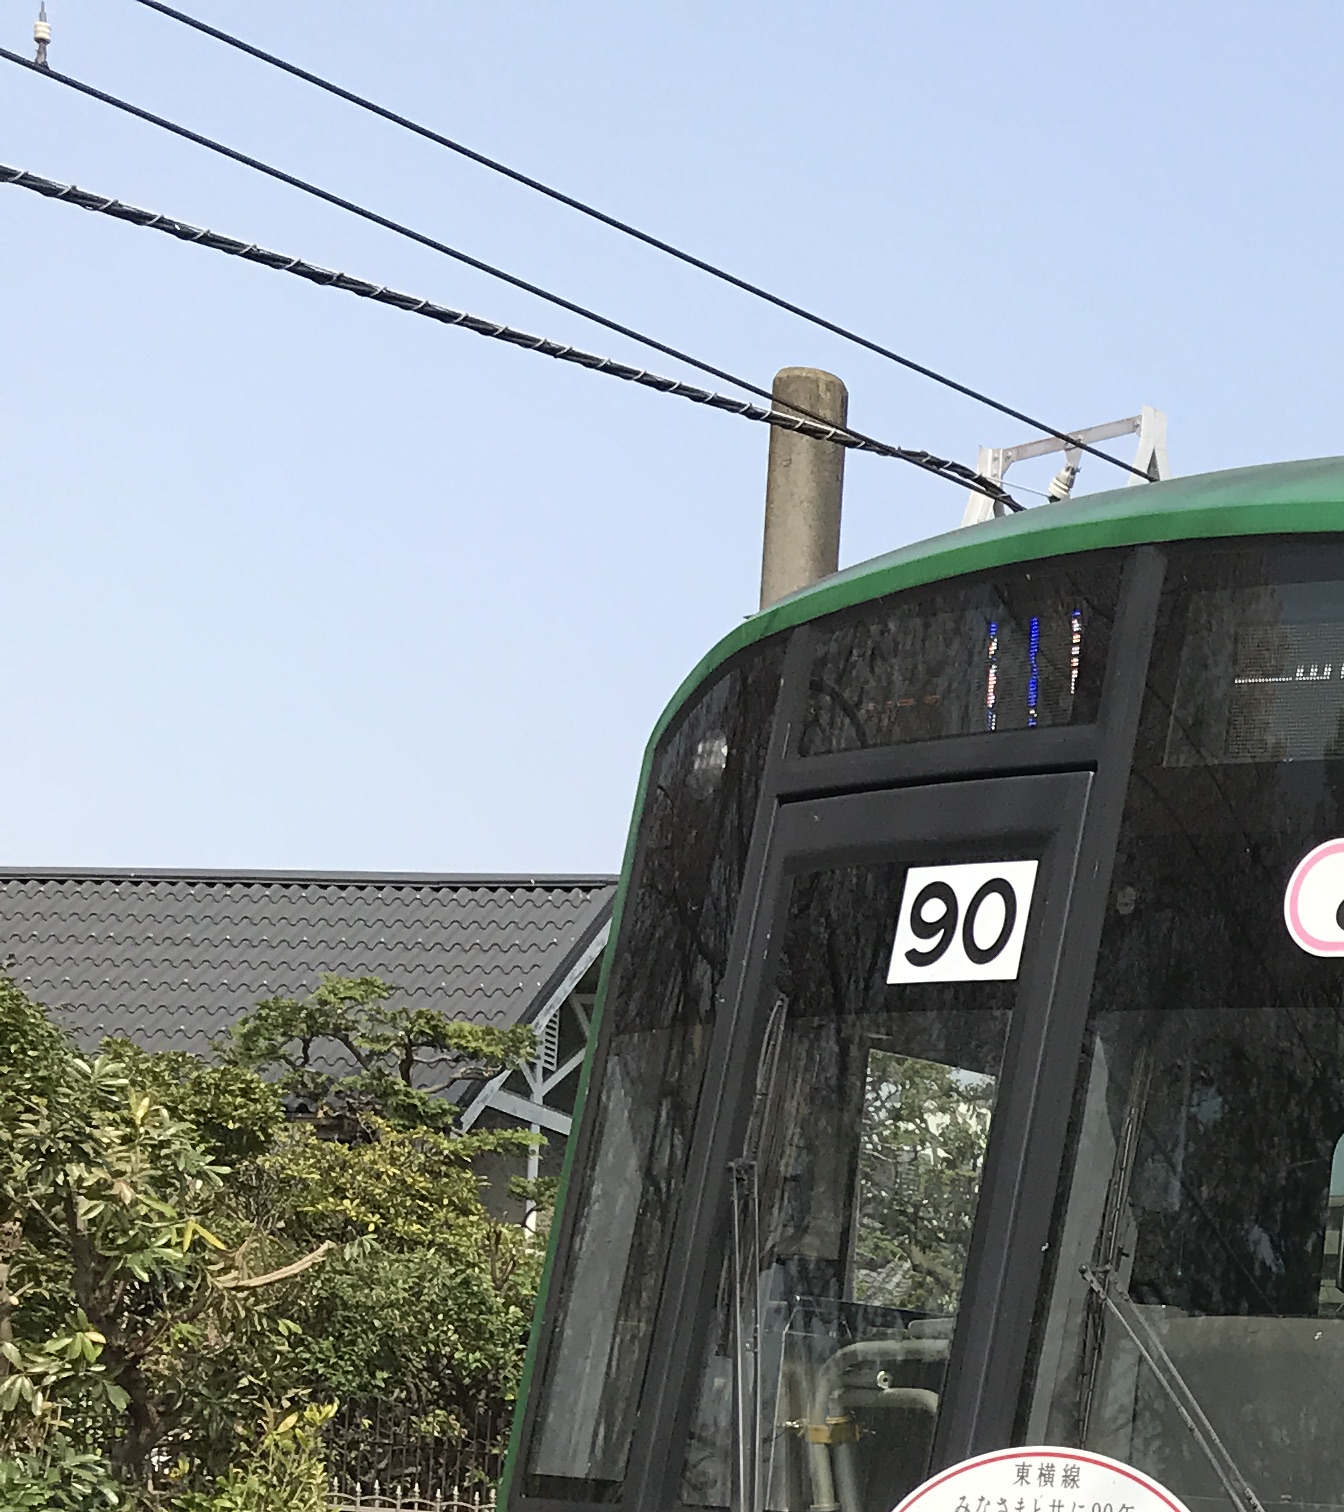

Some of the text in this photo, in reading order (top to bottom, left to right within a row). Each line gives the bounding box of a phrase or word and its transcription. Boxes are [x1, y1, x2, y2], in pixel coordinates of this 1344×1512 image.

[905, 877, 1017, 967] 90
[1012, 1461, 1081, 1489] 東横線
